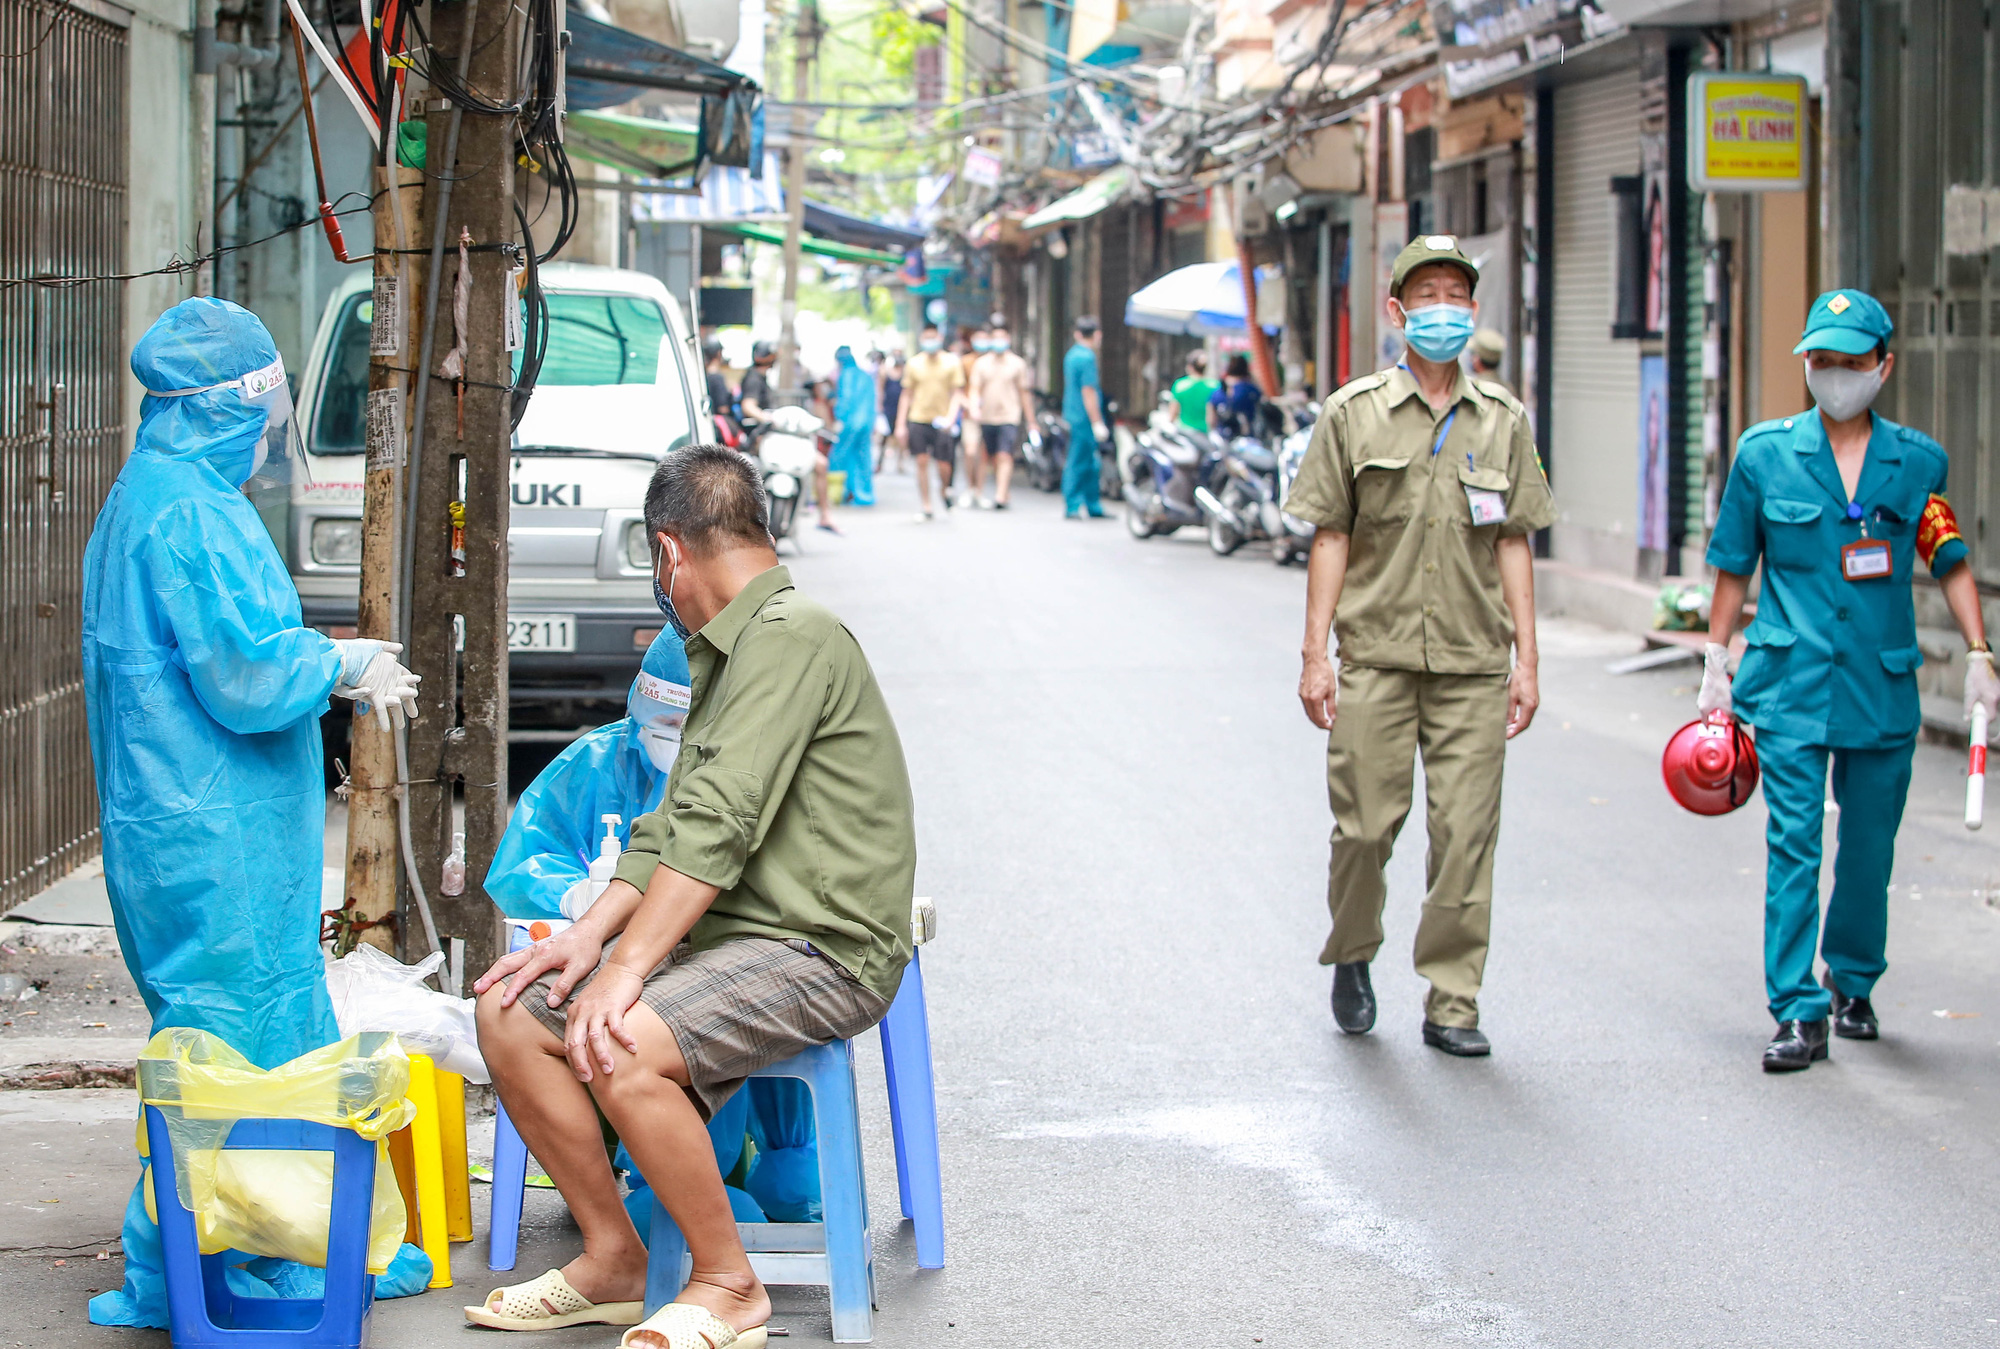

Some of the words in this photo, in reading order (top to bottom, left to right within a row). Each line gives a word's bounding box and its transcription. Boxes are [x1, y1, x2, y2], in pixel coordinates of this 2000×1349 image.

[1747, 118, 1795, 141] LINH
[269, 373, 283, 387] 2A5
[511, 483, 582, 506] UKI
[643, 686, 661, 700] 2A5
[660, 695, 679, 705] CHUNG
